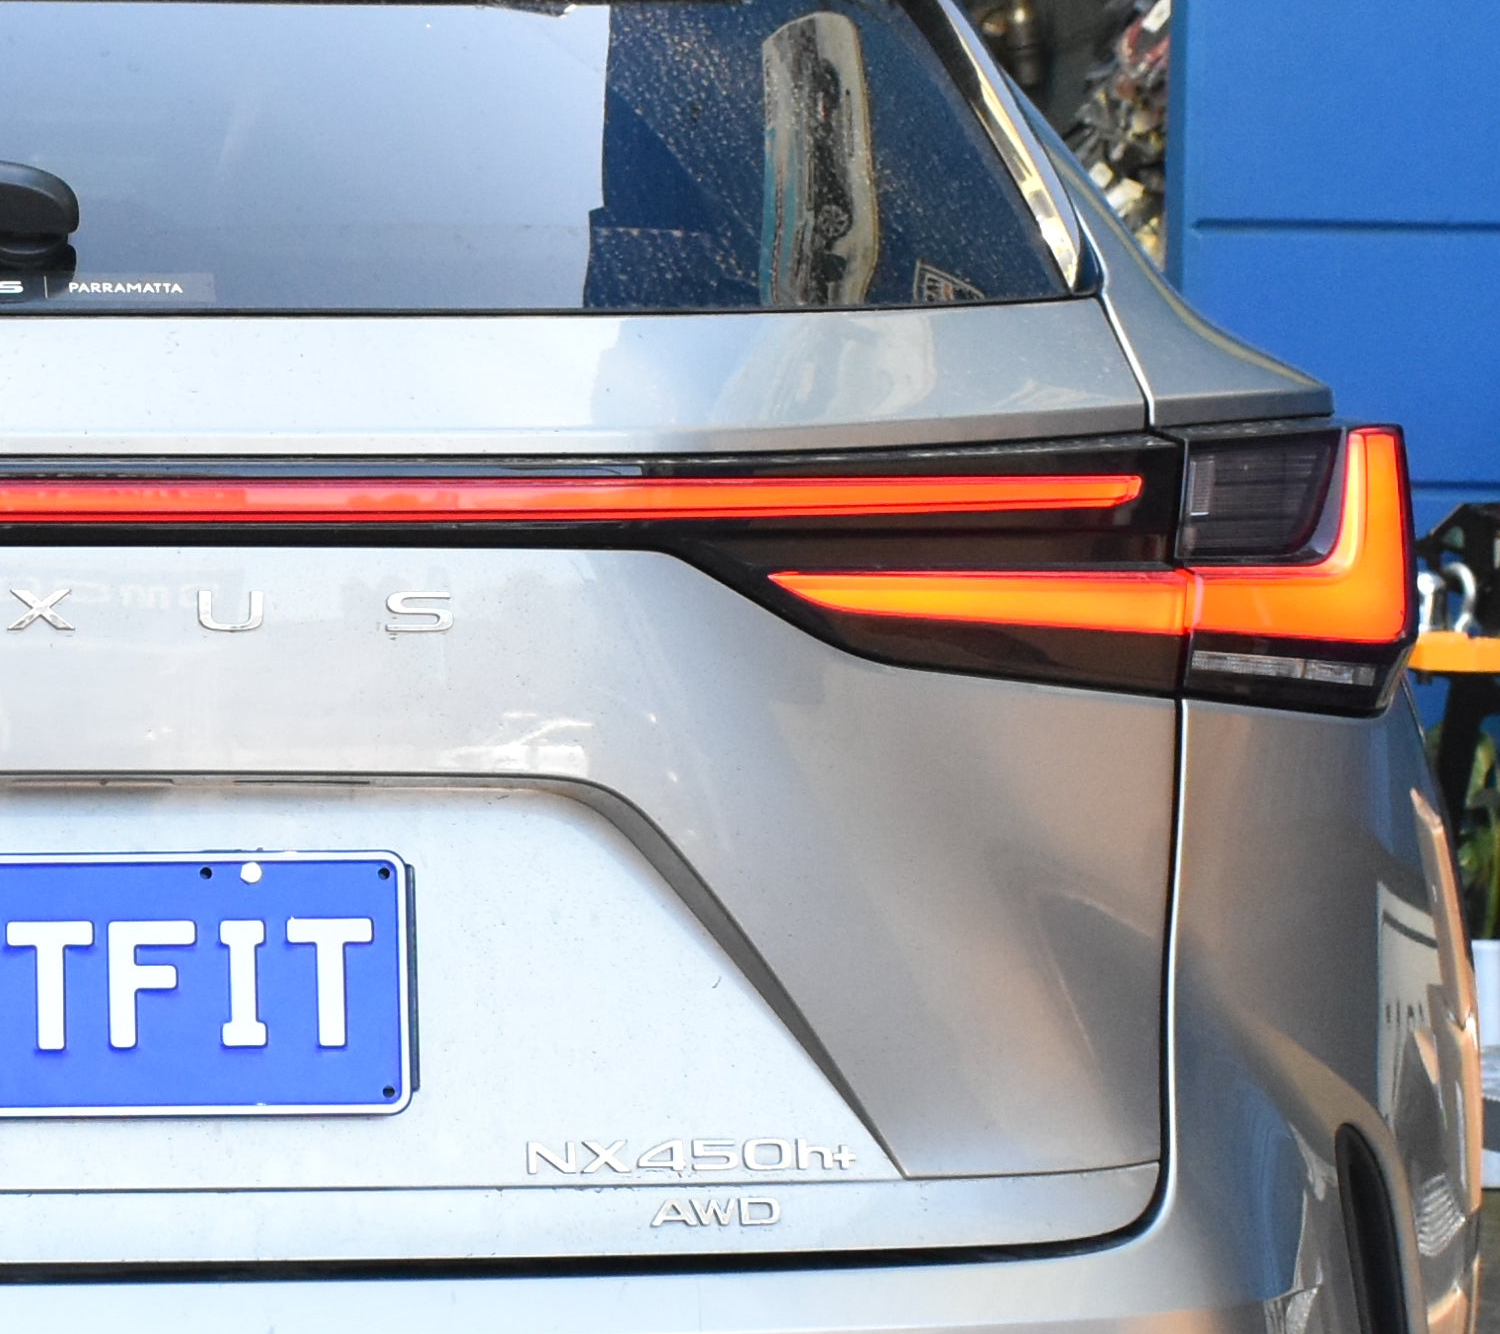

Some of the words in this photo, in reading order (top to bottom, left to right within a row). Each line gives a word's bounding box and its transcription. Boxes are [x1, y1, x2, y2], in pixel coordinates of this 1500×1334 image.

[68, 281, 184, 294] PARRAMATTA
[526, 1138, 857, 1175] NX450h+
[650, 1197, 781, 1228] AWD
